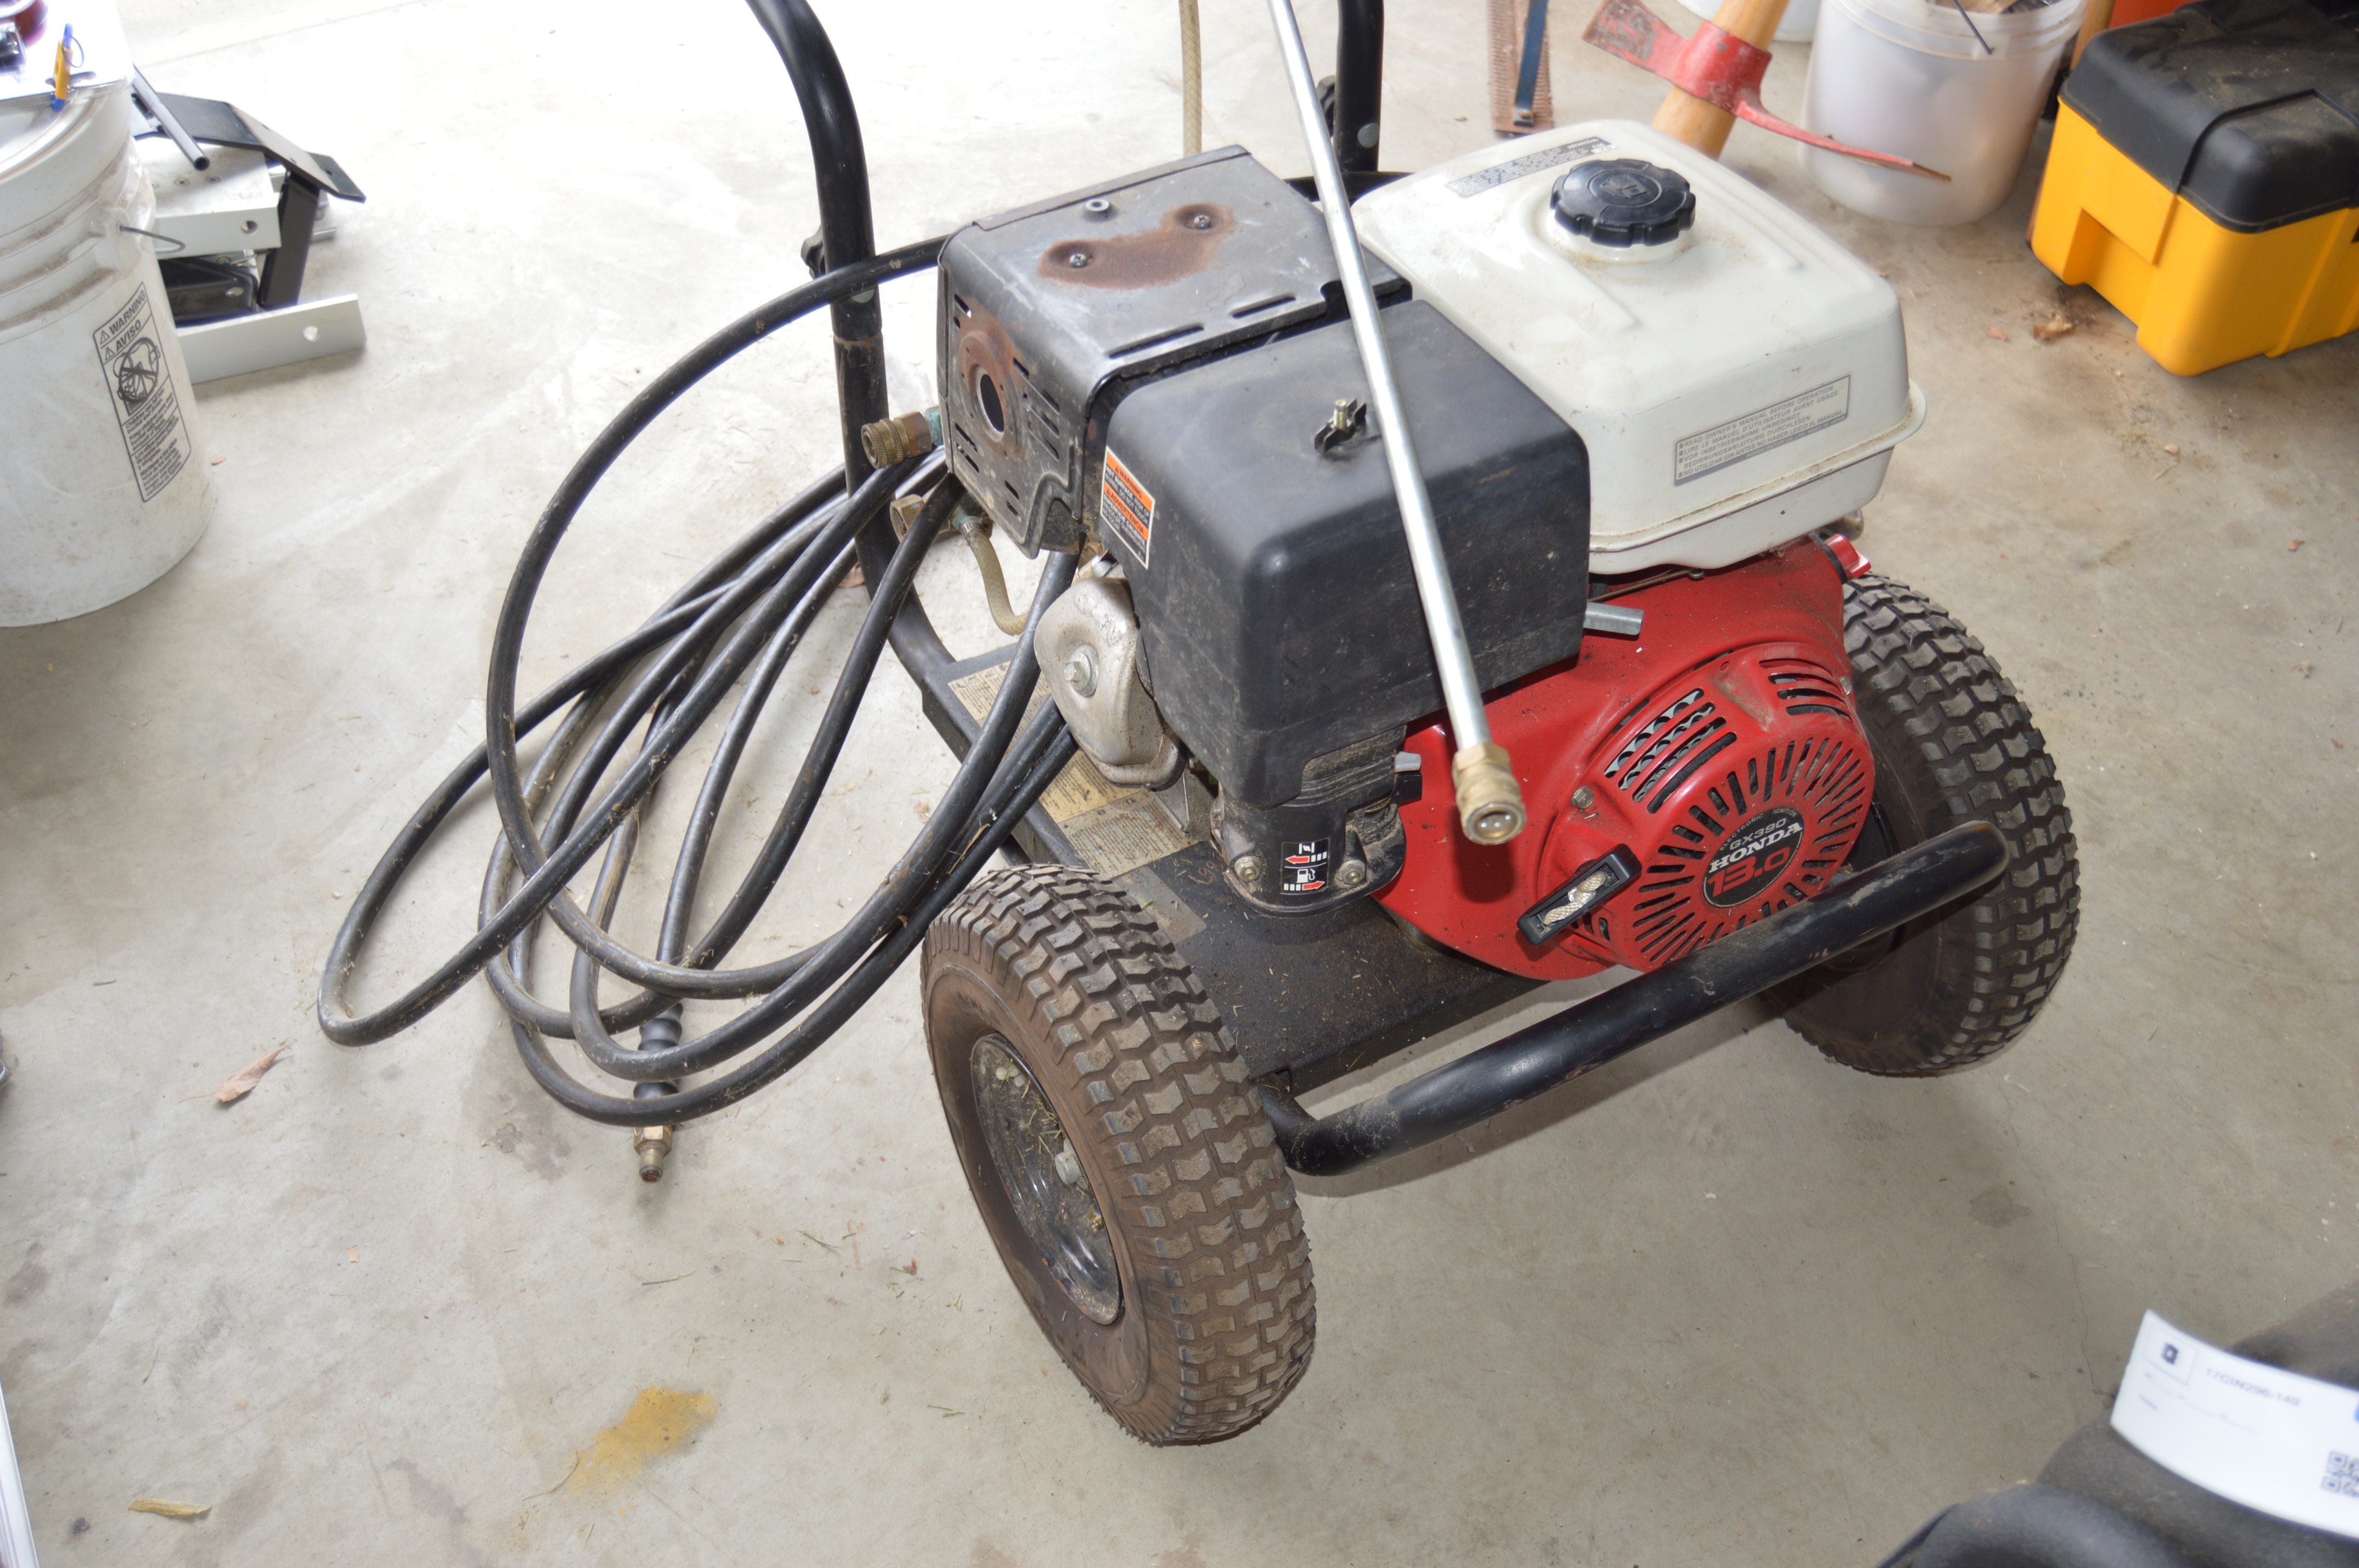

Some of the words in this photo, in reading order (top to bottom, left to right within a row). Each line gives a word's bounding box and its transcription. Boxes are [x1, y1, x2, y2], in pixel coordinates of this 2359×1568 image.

[109, 290, 146, 335] WARNING
[117, 319, 142, 351] AVISO
[125, 411, 145, 429] Children
[129, 429, 142, 440] Keep
[1684, 444, 1698, 454] LIRE
[1712, 428, 1739, 444] MANUEL
[1743, 409, 1790, 432] D'UTILISATEUR
[1793, 399, 1814, 412] AVANT
[1684, 452, 1698, 462] VOR
[1701, 428, 1759, 455] INBETRIEBNAHME
[1762, 412, 1800, 431] UNBEDINGT
[1685, 436, 1702, 447] READ
[1705, 423, 1736, 440] OWNER'S
[1739, 411, 1767, 426] MANUAL
[1770, 400, 1794, 414] BEFORE
[1684, 433, 1764, 469] BEDIENUNGSANLEITUNG
[1694, 456, 1722, 472] UTILIZAR
[1724, 452, 1734, 460] SIN
[1736, 443, 1755, 456] ANTES
[1767, 431, 1788, 443] HABER
[1790, 423, 1807, 434] LEIDO
[1119, 469, 1141, 499] WARNING
[1110, 492, 1143, 534] ADVERTENCIA
[1709, 822, 1803, 873] HONDA
[1720, 813, 1764, 851] ELECTRONIC
[1772, 807, 1797, 816] IGNITION
[1729, 817, 1786, 850] GX390
[1707, 846, 1790, 897] 13.0
